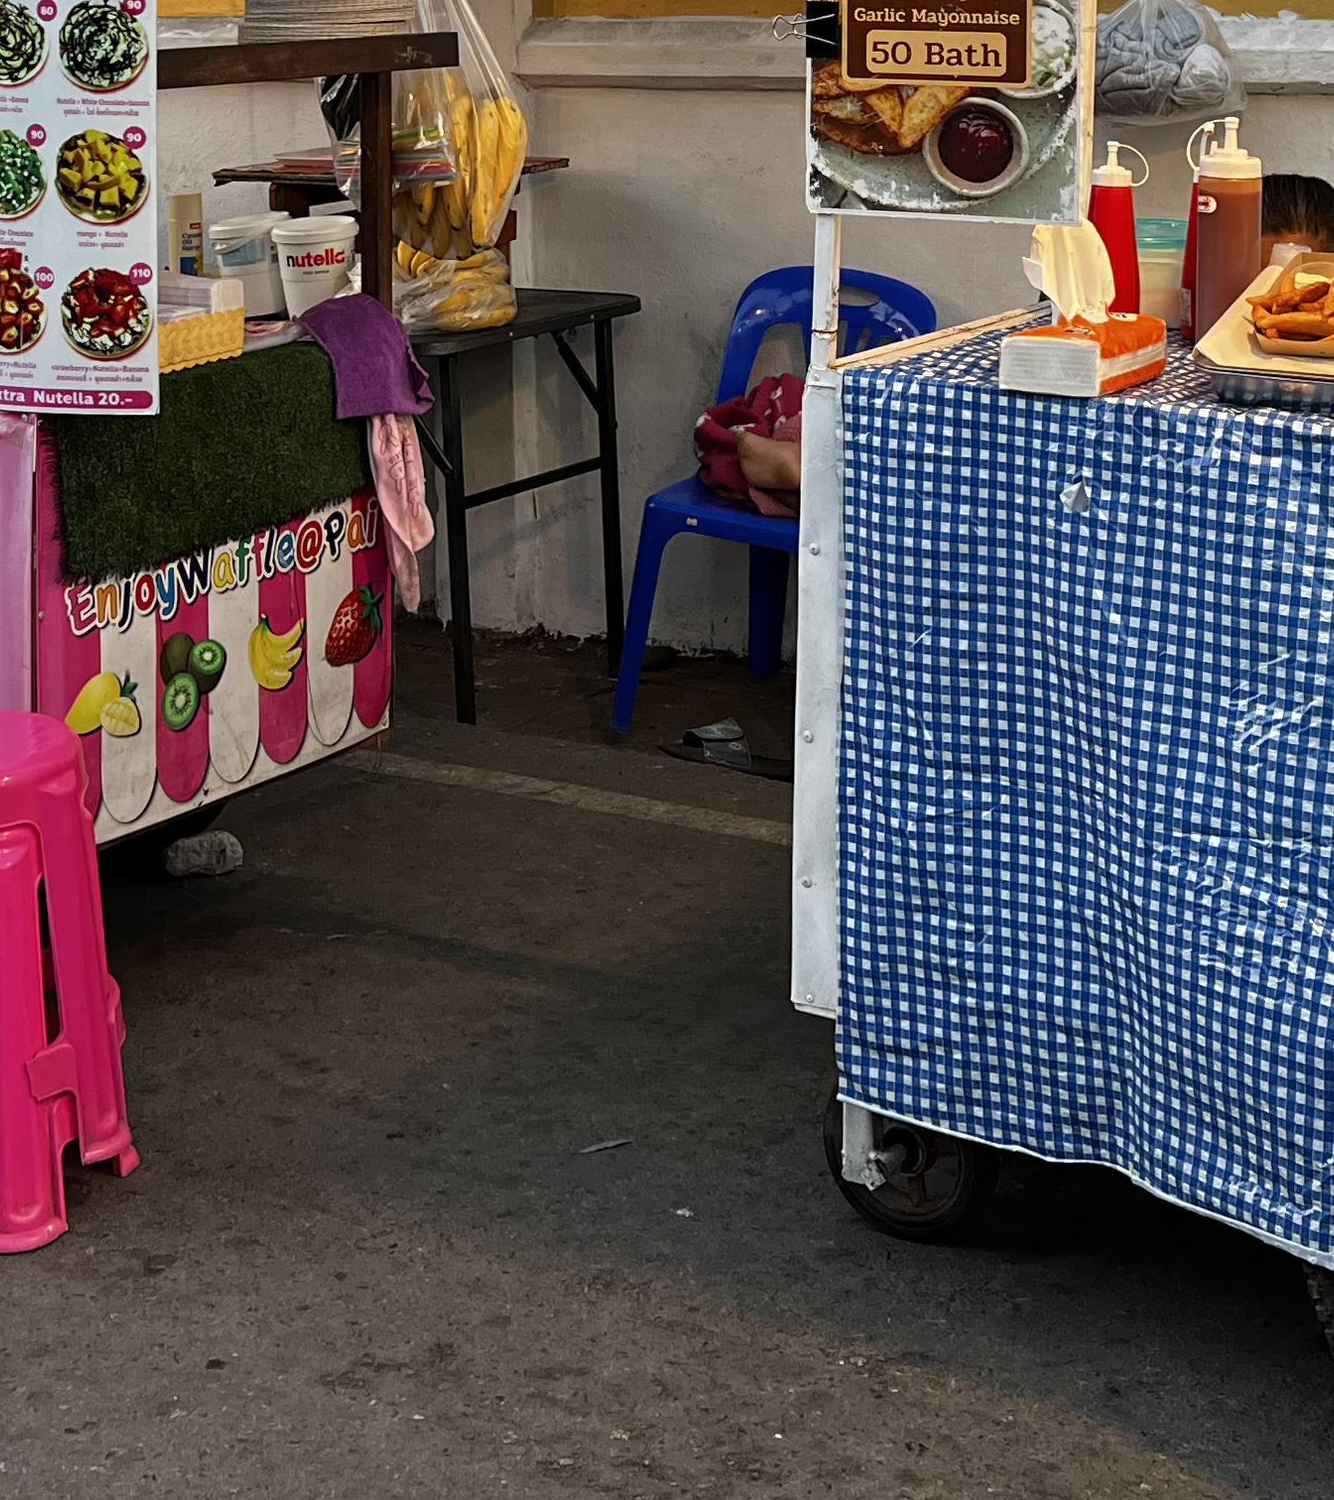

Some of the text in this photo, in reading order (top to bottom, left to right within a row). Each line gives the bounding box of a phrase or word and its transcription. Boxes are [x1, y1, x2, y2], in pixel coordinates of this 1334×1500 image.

[126, 0, 142, 10] 90
[40, 6, 54, 16] 80
[854, 7, 1021, 28] Garlic Mayonnaise
[871, 41, 1003, 68] 50 Bath
[30, 130, 44, 140] 90
[126, 133, 142, 142] 90
[286, 248, 346, 268] nutella
[35, 272, 54, 282] 100
[132, 268, 152, 278] 110
[33, 390, 94, 405] Nutella
[98, 392, 133, 406] 20.-
